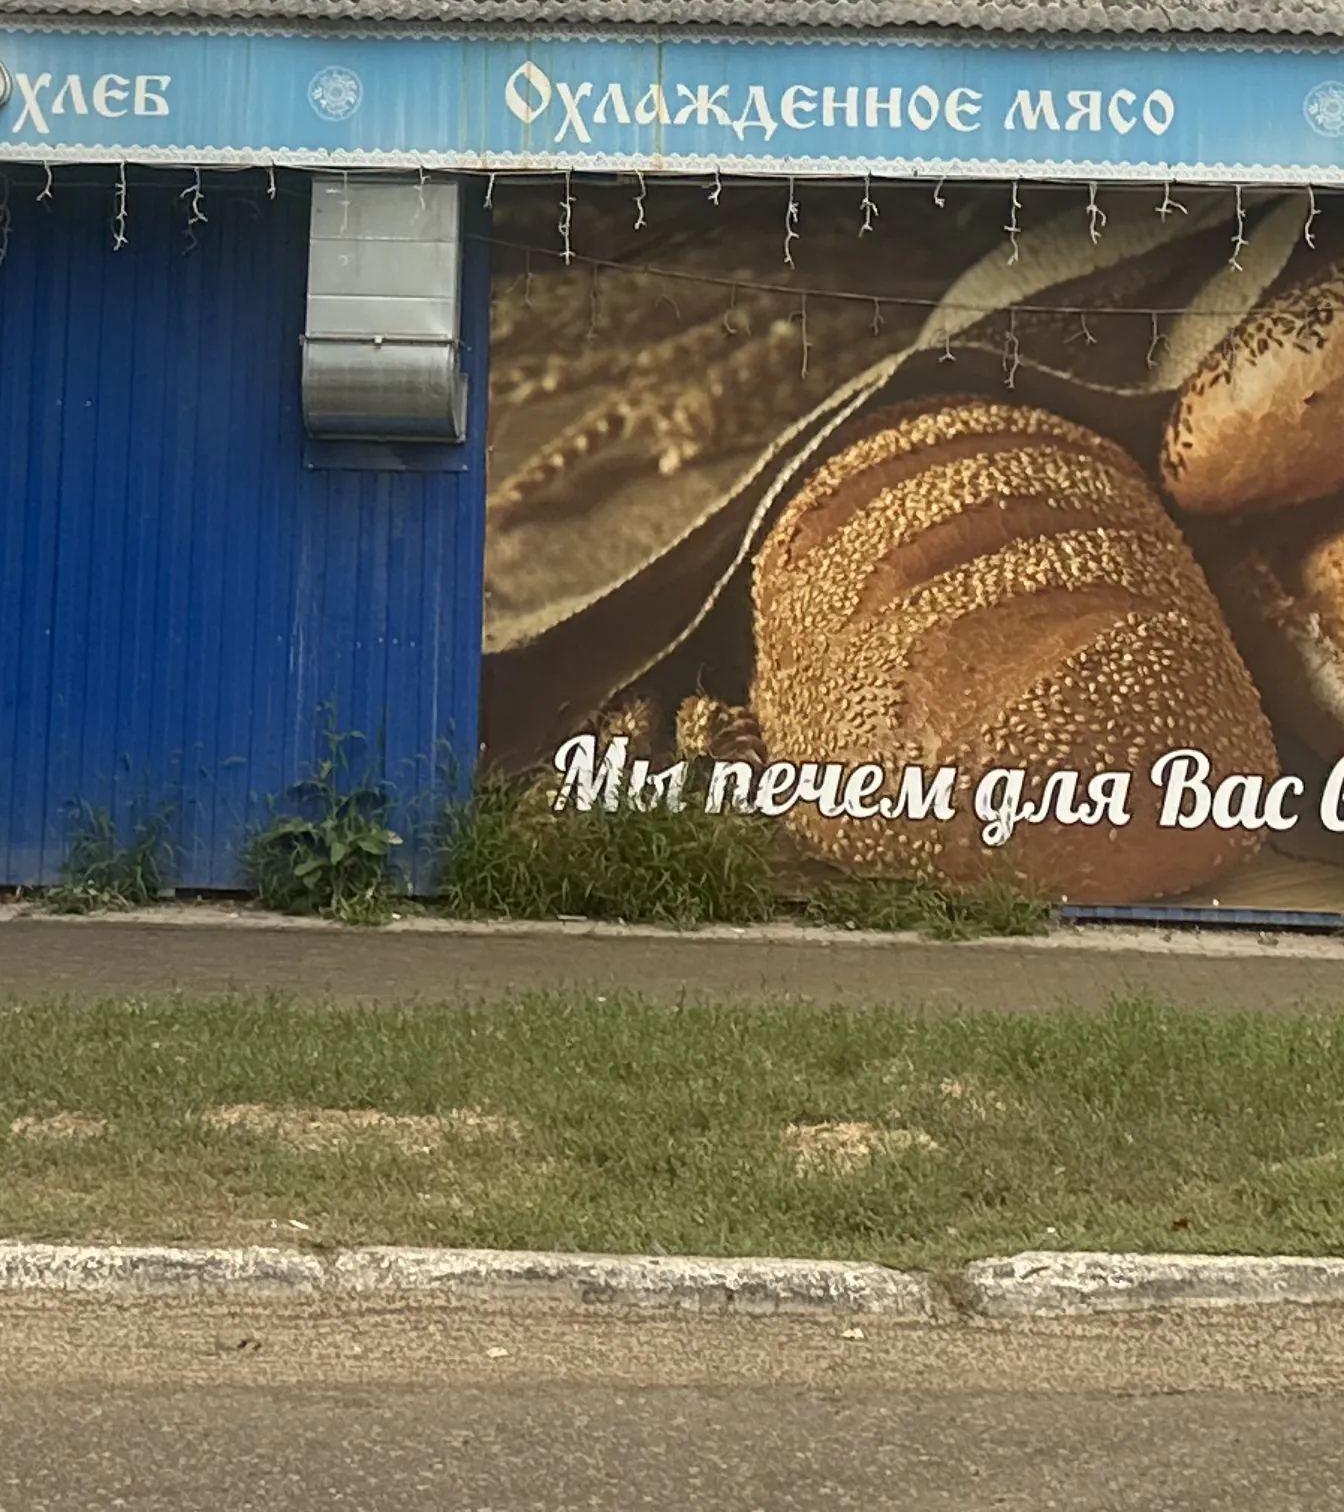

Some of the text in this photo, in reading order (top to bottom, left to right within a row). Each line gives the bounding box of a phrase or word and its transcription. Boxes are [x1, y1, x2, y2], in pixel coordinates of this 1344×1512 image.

[553, 733, 687, 814] Мы
[706, 759, 957, 820] печем
[973, 767, 1132, 847] для
[1151, 747, 1305, 831] Вас
